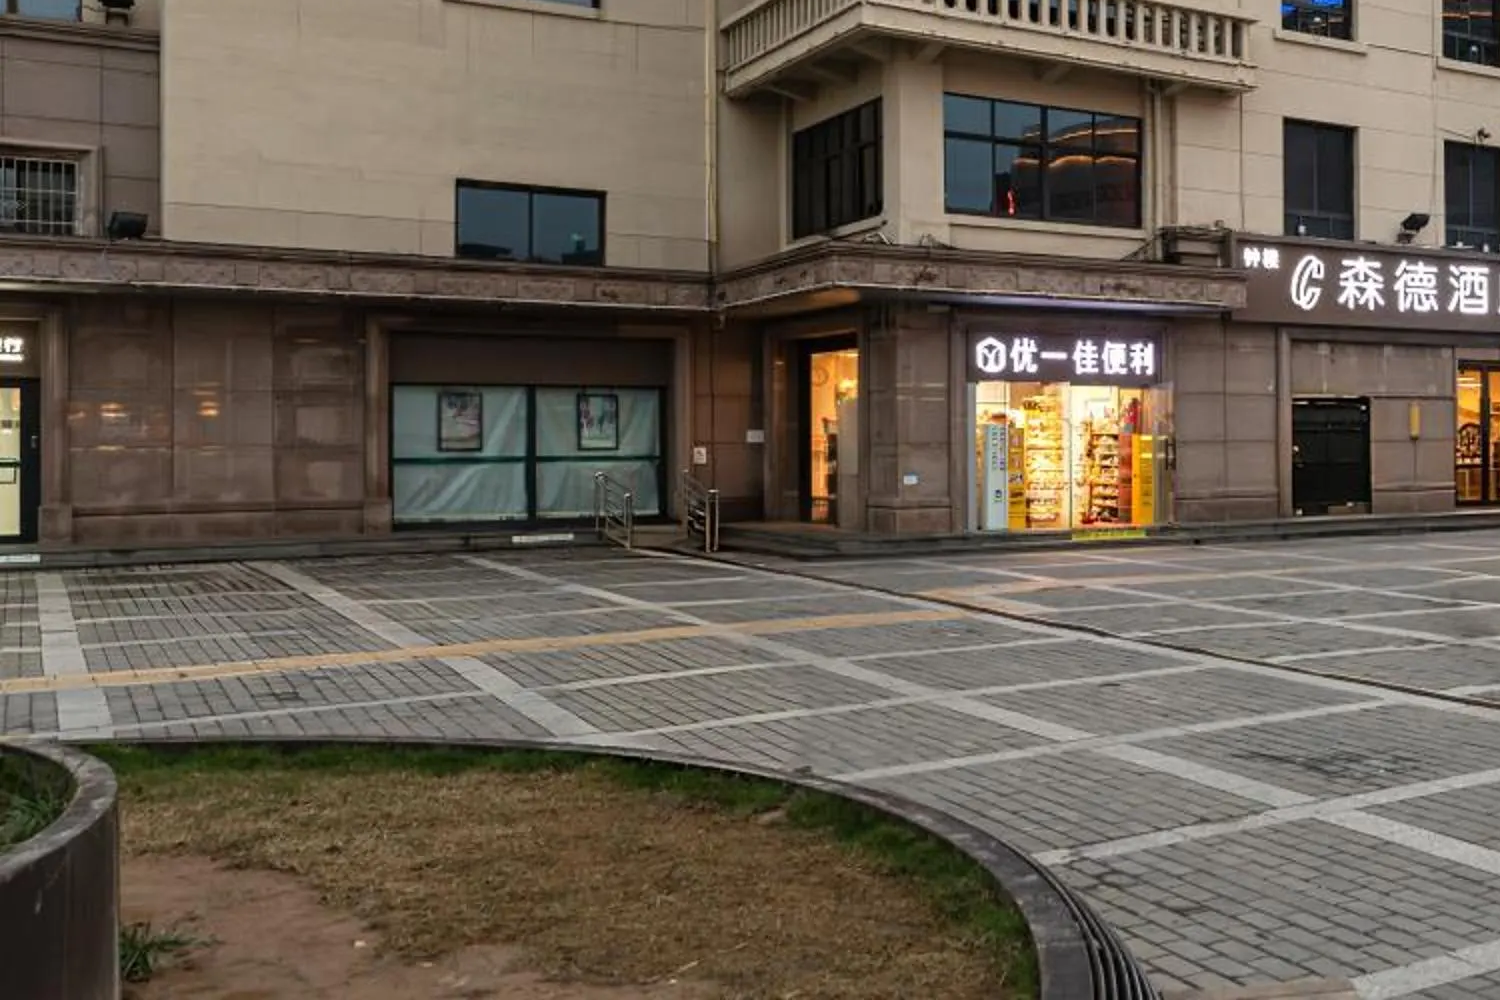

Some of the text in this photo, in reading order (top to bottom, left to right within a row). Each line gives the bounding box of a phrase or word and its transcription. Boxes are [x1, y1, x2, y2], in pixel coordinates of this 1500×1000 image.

[1009, 337, 1155, 376] 优一佳便利
